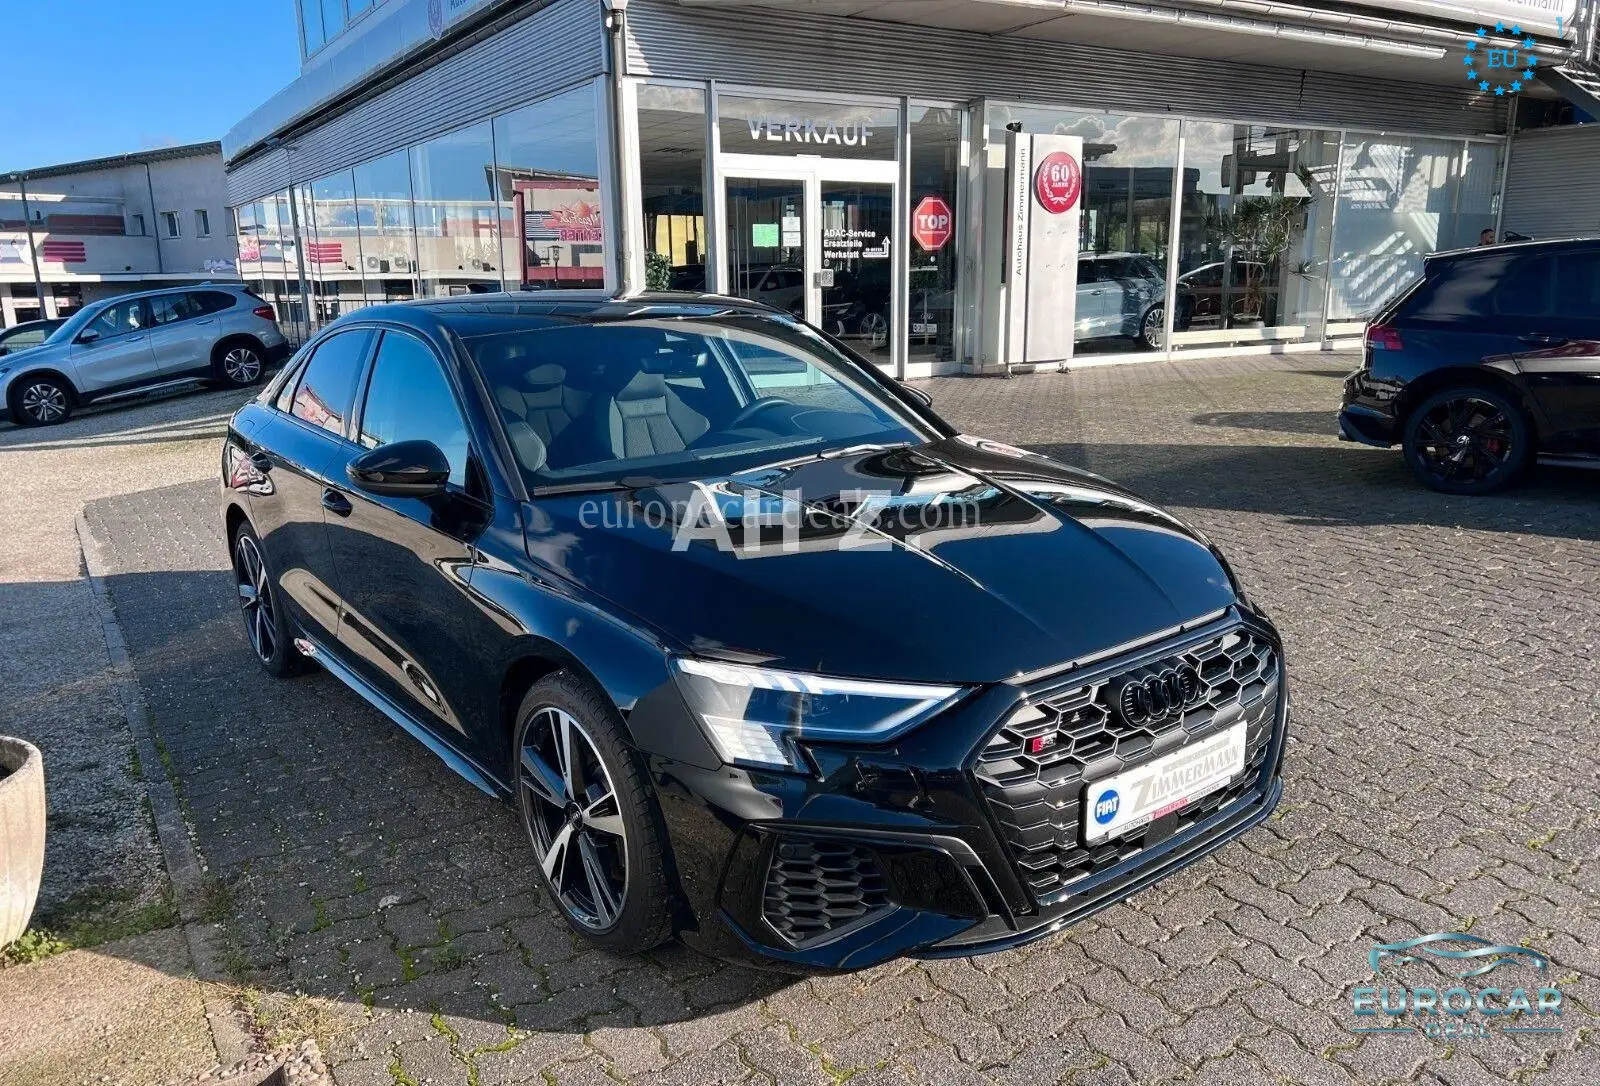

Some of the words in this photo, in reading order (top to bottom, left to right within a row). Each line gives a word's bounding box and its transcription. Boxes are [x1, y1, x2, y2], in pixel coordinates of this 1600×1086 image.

[745, 116, 874, 146] VERKAUF
[1051, 164, 1070, 182] 60
[1017, 148, 1026, 222] Zimmermann
[917, 214, 948, 230] TOP
[823, 229, 876, 238] ADAC-Service
[823, 239, 863, 248] Ersatzteile
[823, 250, 860, 259] Werkstatt
[1016, 225, 1024, 276] Autohaus
[1130, 744, 1240, 815] ZIMMERMANN
[1096, 796, 1119, 819] FIAT
